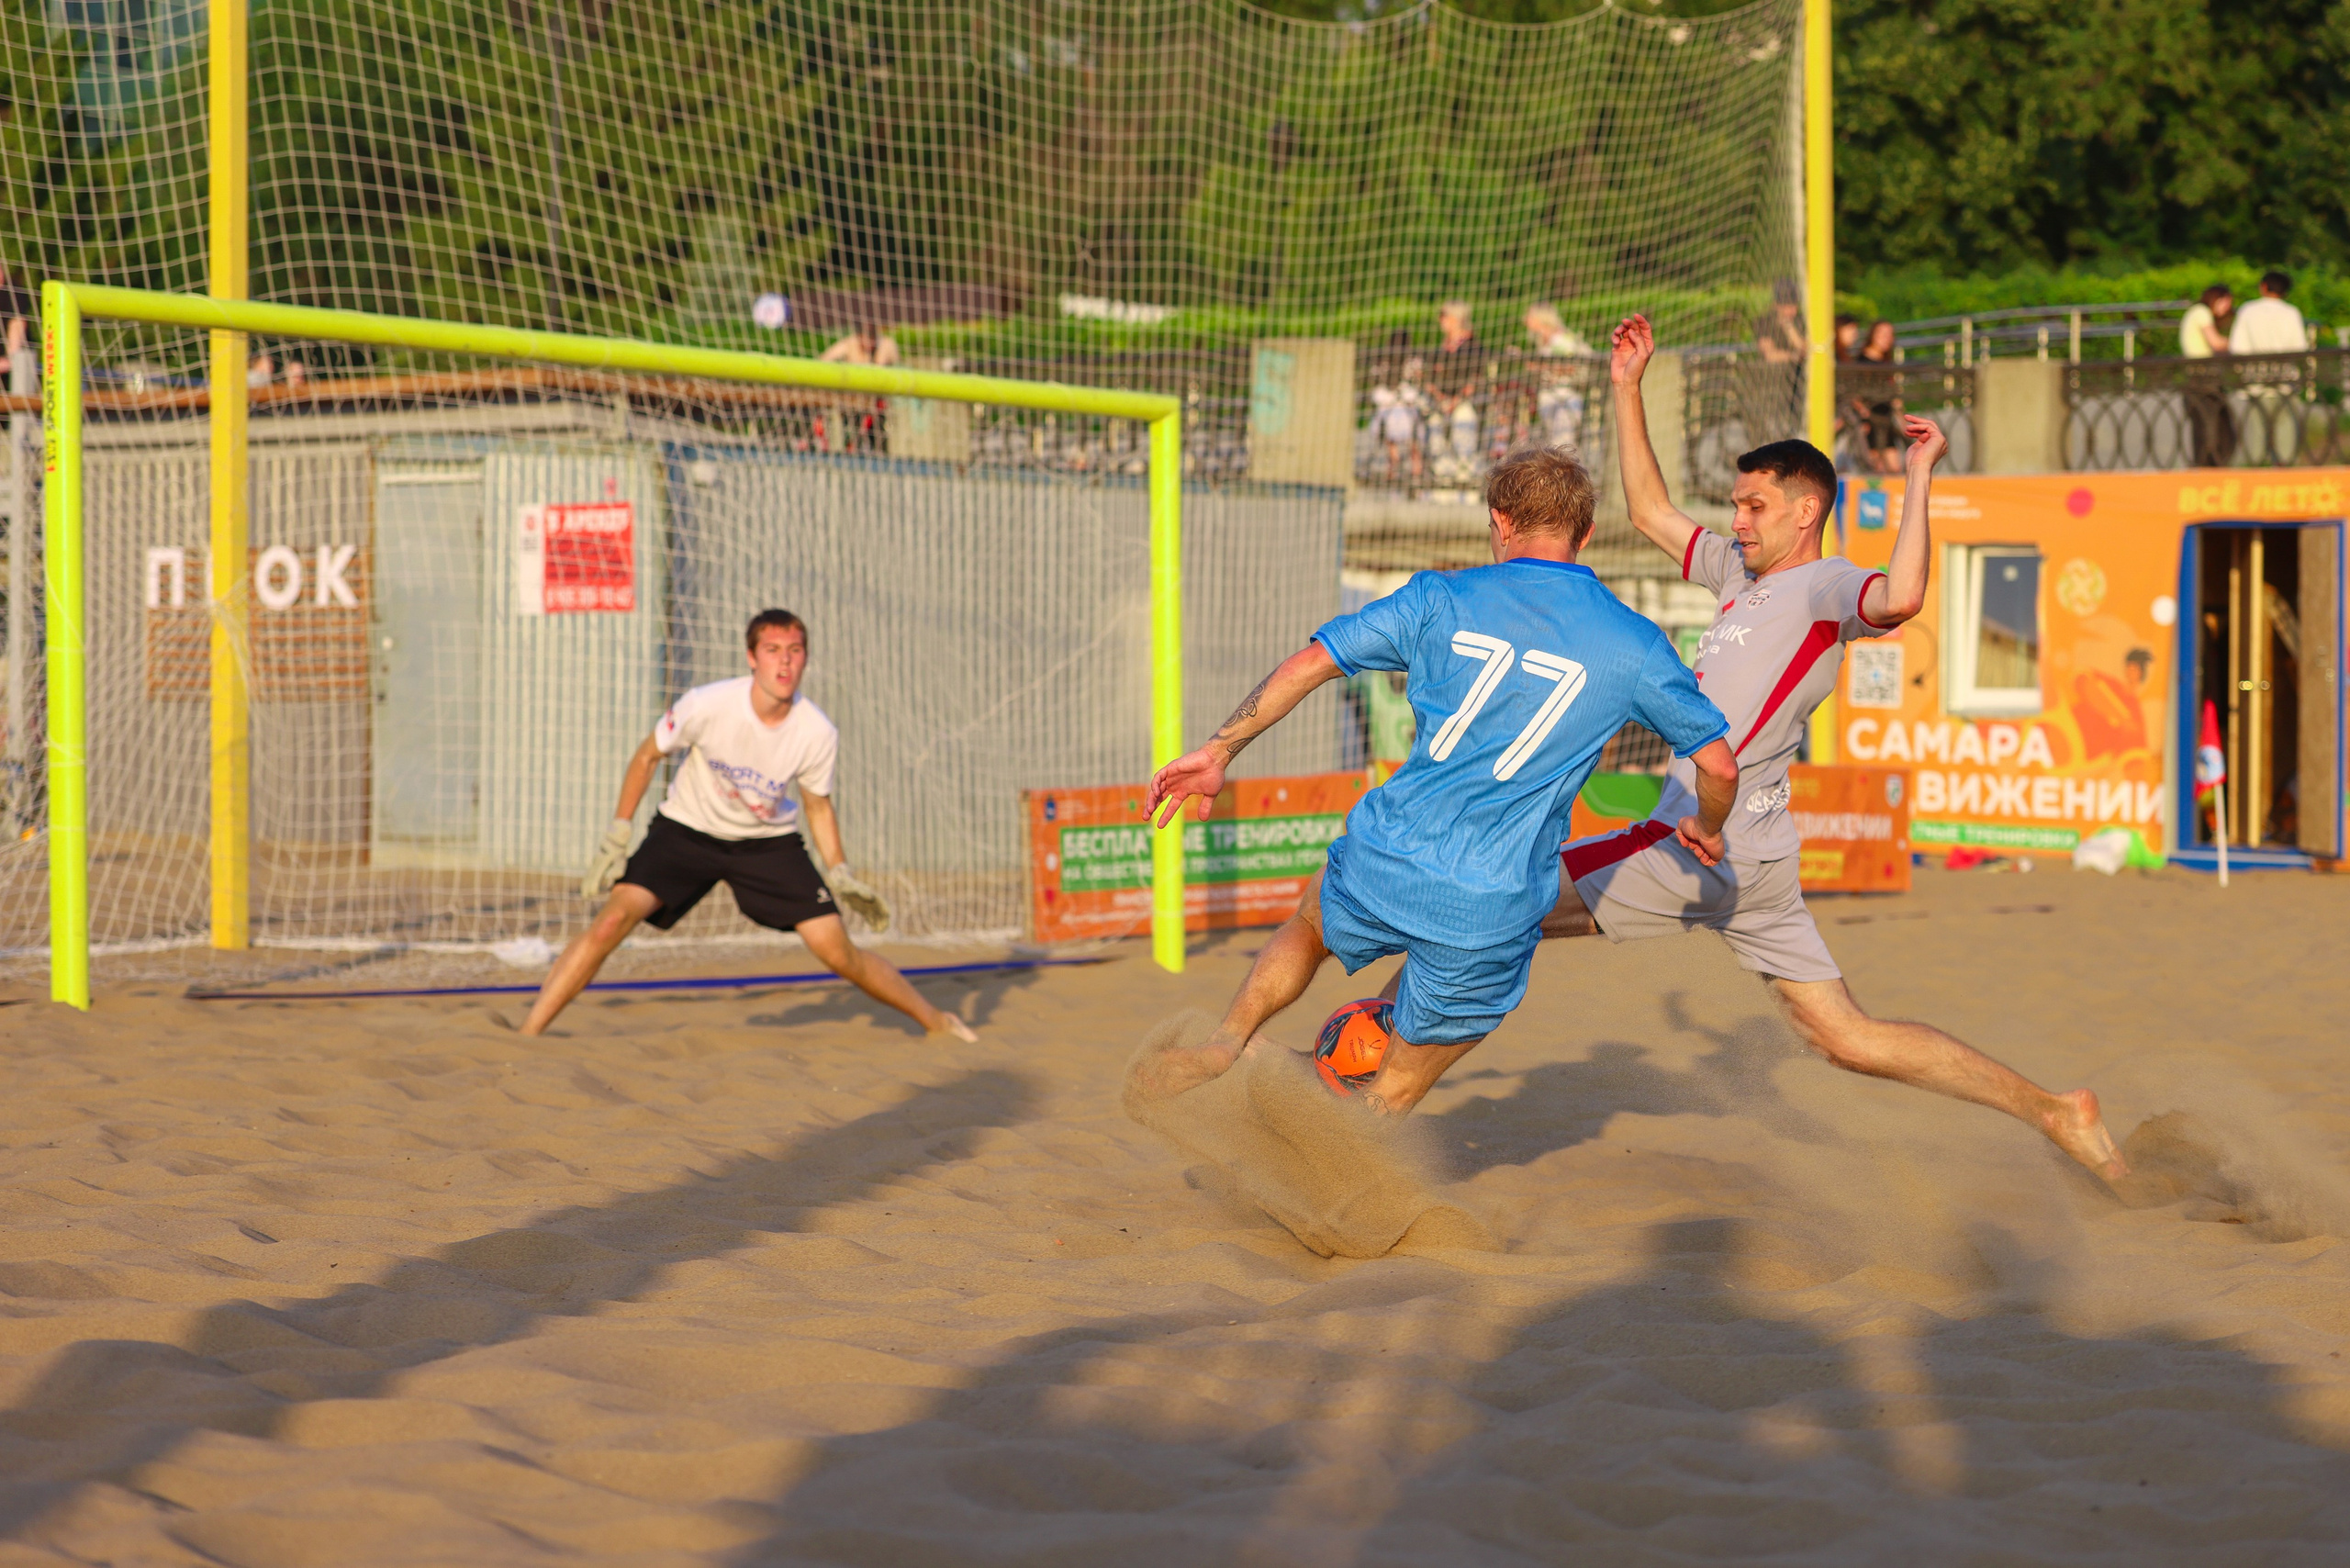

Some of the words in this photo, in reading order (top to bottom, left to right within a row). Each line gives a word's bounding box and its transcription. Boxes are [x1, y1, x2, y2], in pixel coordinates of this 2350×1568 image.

[2178, 478, 2240, 514] ВСЁ
[148, 544, 359, 610] ПОК
[1428, 630, 1587, 782] 77
[1847, 718, 2054, 767] САМАРА
[1908, 769, 2165, 823] ВИЖЕНИИ
[1210, 818, 1344, 851] ТРЕНИРОВКИ
